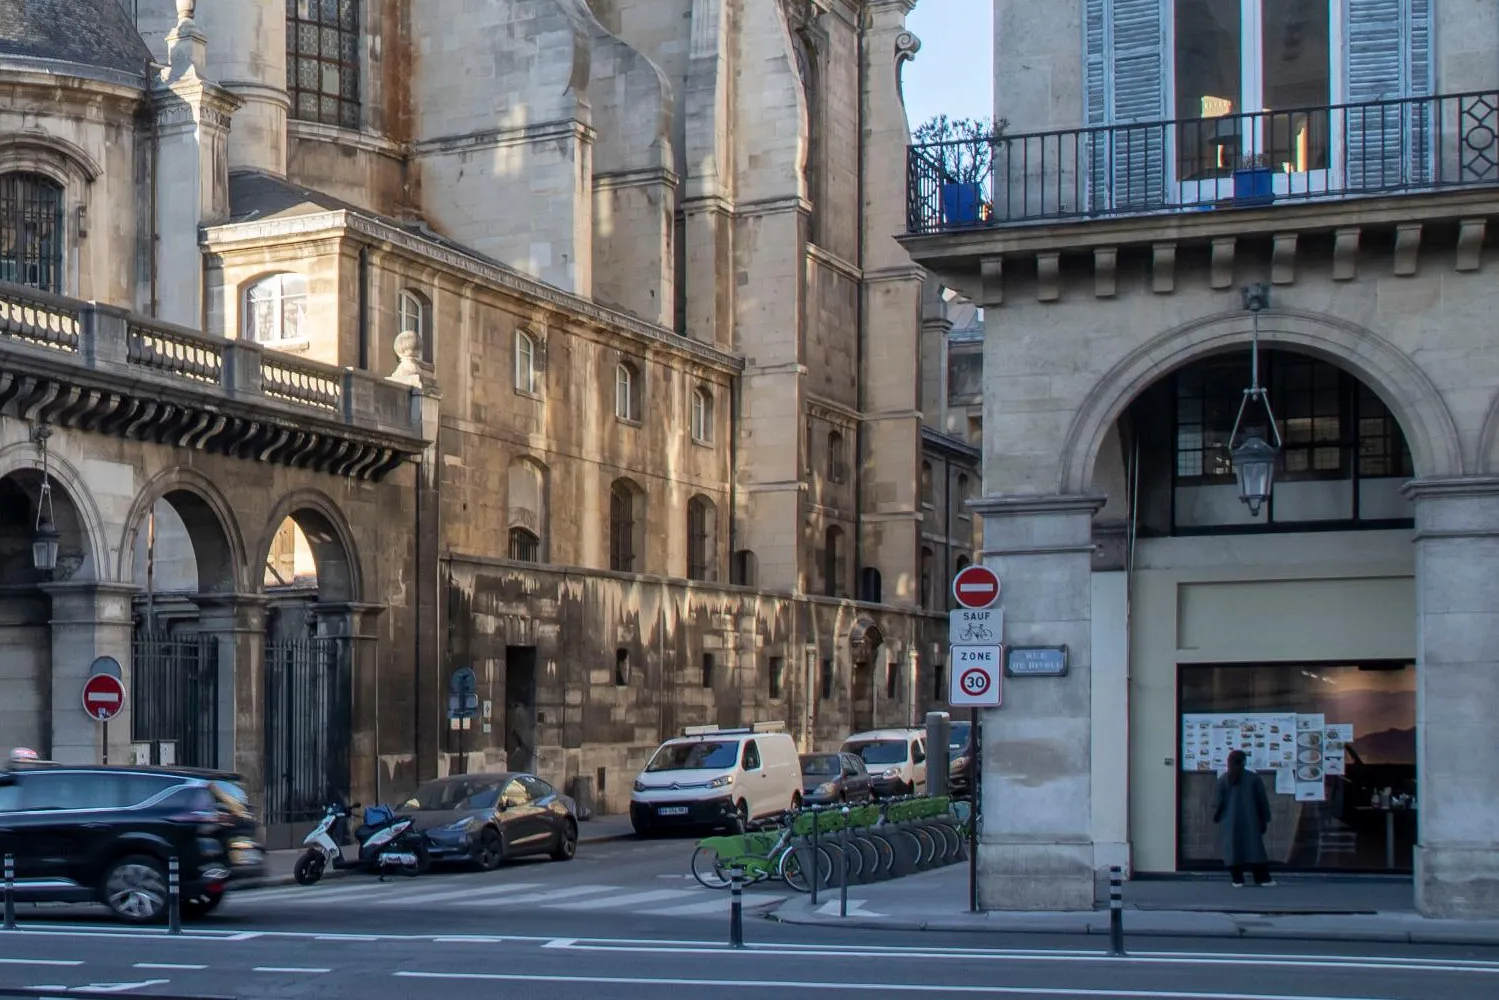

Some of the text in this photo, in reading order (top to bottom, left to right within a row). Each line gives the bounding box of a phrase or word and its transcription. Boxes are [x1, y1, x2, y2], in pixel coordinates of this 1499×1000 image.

[963, 612, 990, 620] SAUF
[961, 652, 991, 660] ZONE
[966, 677, 985, 688] 30
